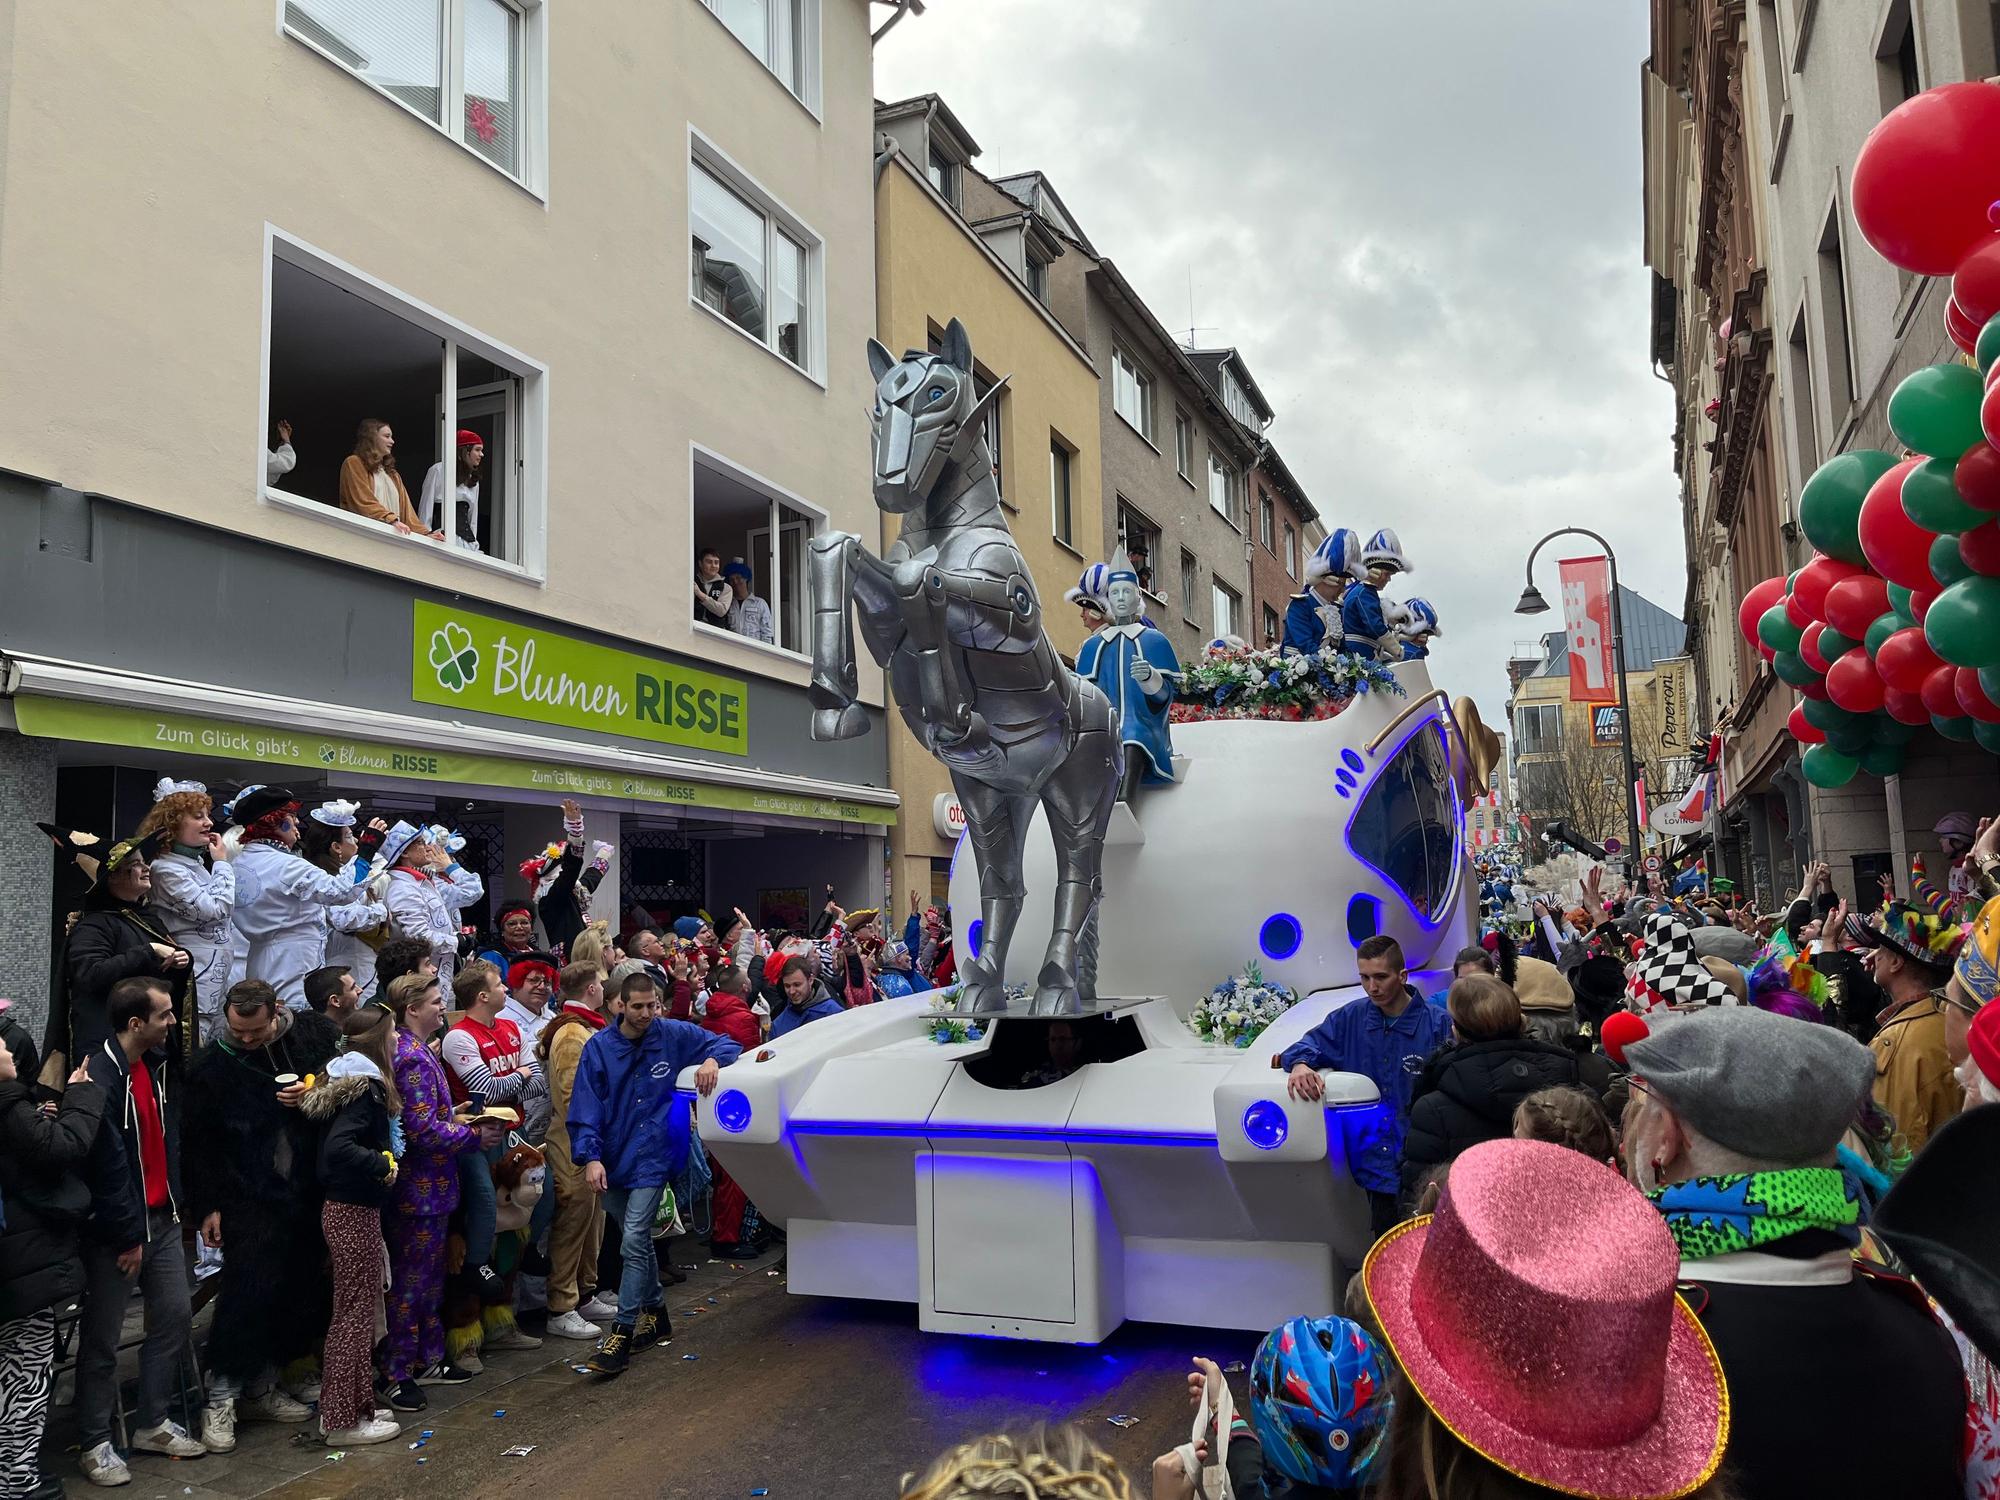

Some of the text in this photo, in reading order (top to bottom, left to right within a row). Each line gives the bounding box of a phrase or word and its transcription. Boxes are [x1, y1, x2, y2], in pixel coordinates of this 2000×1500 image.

[492, 635, 740, 739] Blumen RISSE
[1678, 682, 1687, 716] ESPRESSO
[1660, 671, 1681, 748] Peperoni
[155, 723, 300, 757] Zum Glück gibt's
[339, 747, 438, 774] Blumen RISSE
[531, 769, 613, 791] Zum Glück gibt's
[635, 781, 695, 800] Blumen RISSE
[753, 797, 768, 808] Zum
[489, 1051, 520, 1074] REW
[656, 1206, 672, 1221] URE
